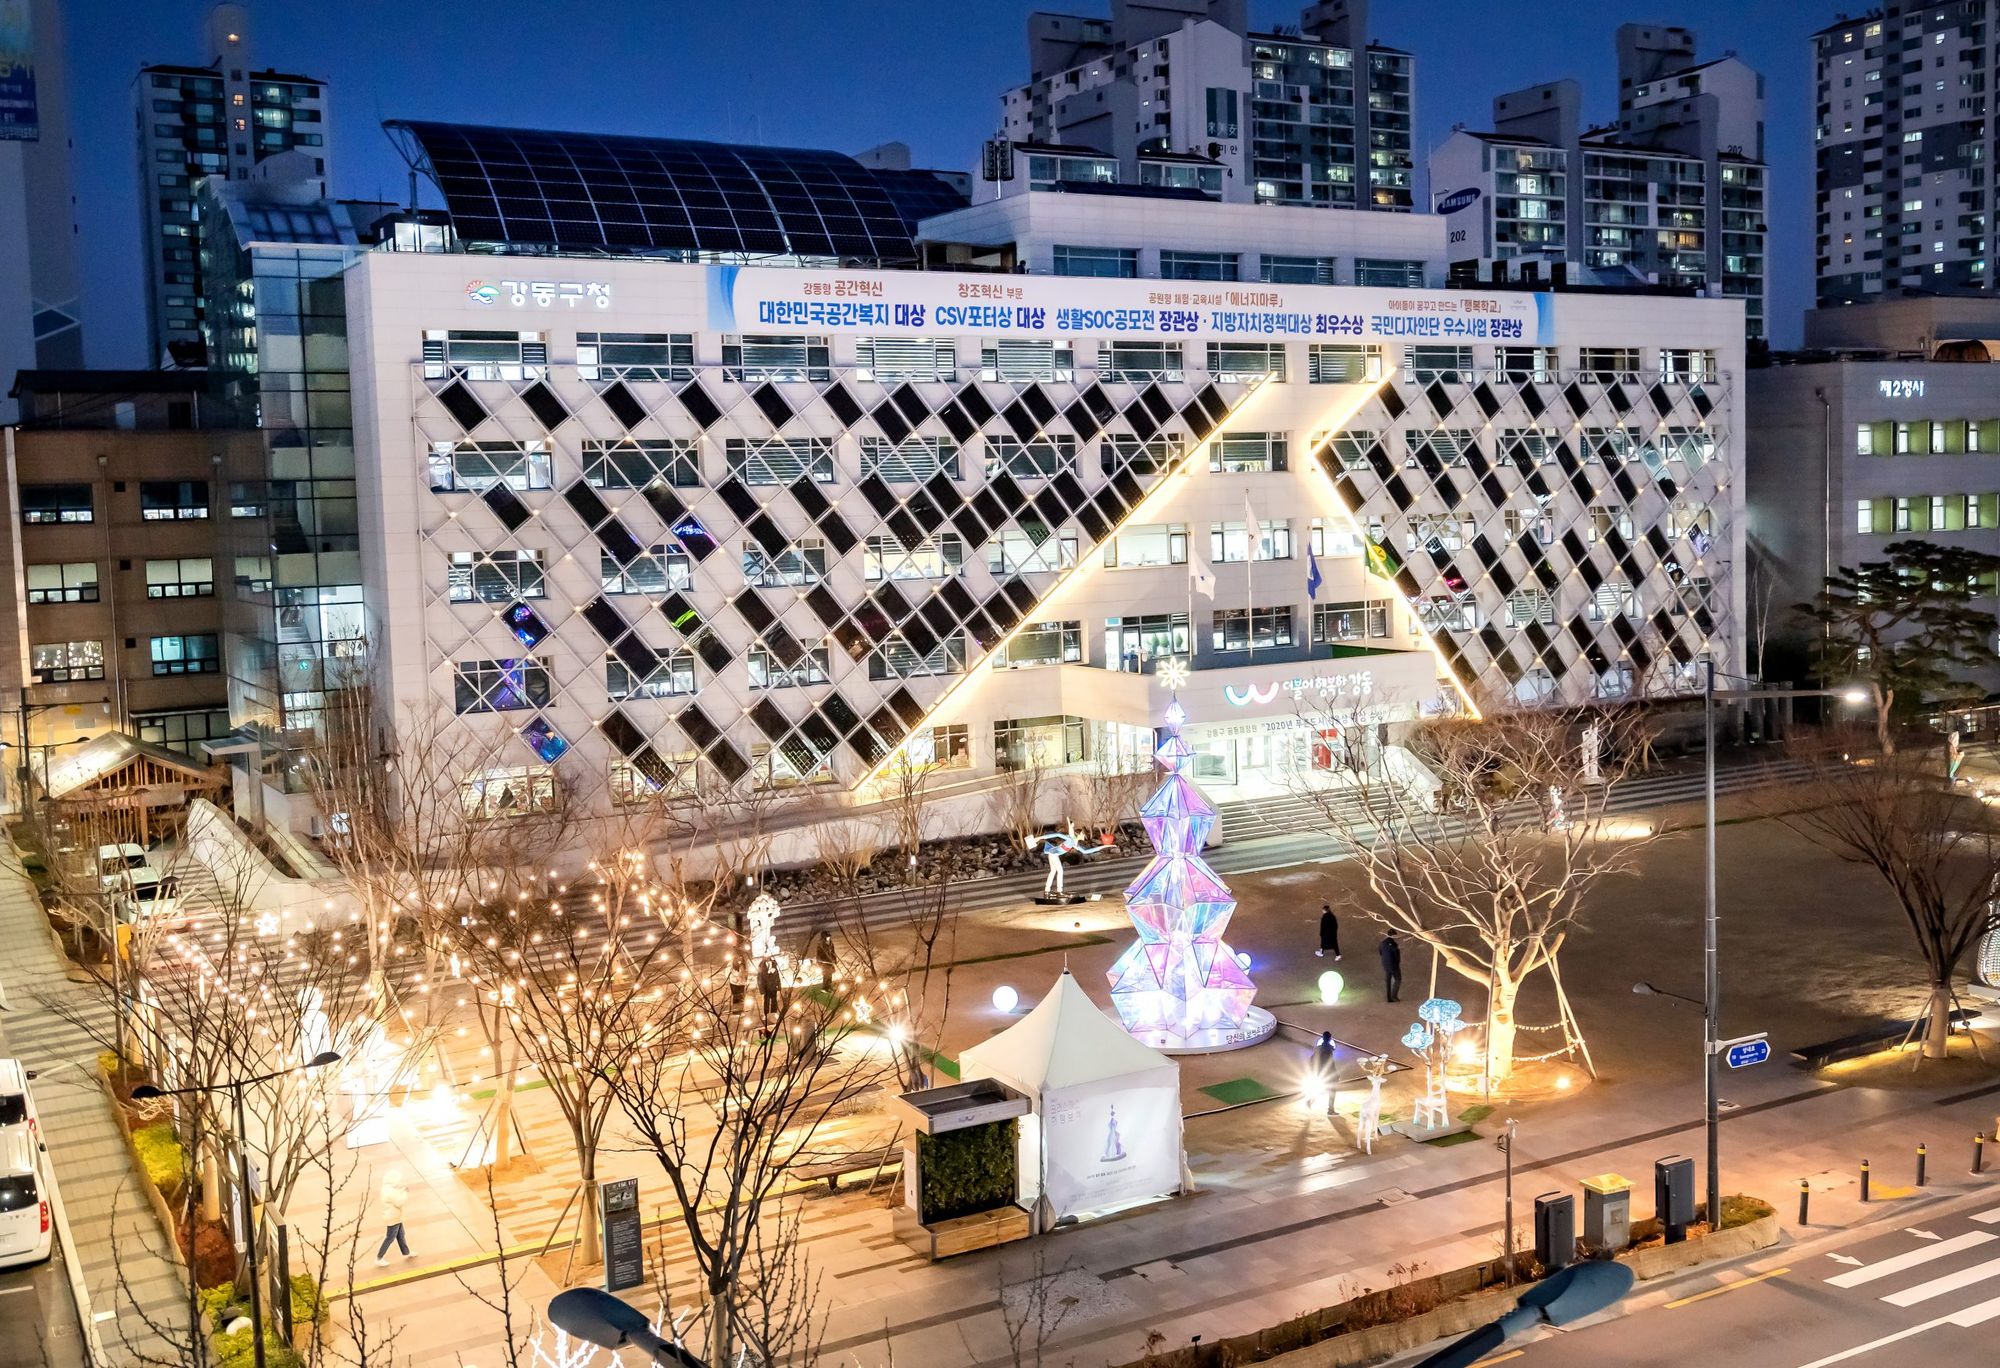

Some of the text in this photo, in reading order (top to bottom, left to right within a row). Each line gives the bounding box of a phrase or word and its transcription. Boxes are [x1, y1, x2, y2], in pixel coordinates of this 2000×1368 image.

[1450, 230, 1466, 243] 202
[501, 280, 610, 309] 강동구청
[803, 280, 883, 297] 강동형 공간혁신
[958, 282, 1023, 300] 창조혁신 부문
[1149, 292, 1172, 305] 공원형
[1388, 299, 1415, 311] 아이들이
[1438, 301, 1457, 312] 만드는
[1460, 299, 1502, 314] 「행복학교」
[759, 300, 926, 327] 대한민국공간복지 대상
[935, 305, 1046, 330] CSV포터상 대상
[1056, 308, 1155, 332] 생활SOC공모전
[1159, 310, 1199, 333] 장관상
[1211, 311, 1313, 335] 지방자치정책대상
[1315, 313, 1364, 336] 최우수상
[1371, 315, 1523, 339] 국민디자인단 우수사업 장관상
[1880, 380, 1924, 398] 제2청사
[1282, 671, 1374, 700] 더불어 행복한 강동
[1207, 728, 1226, 739] 강동구
[1226, 1032, 1245, 1045] 당신의
